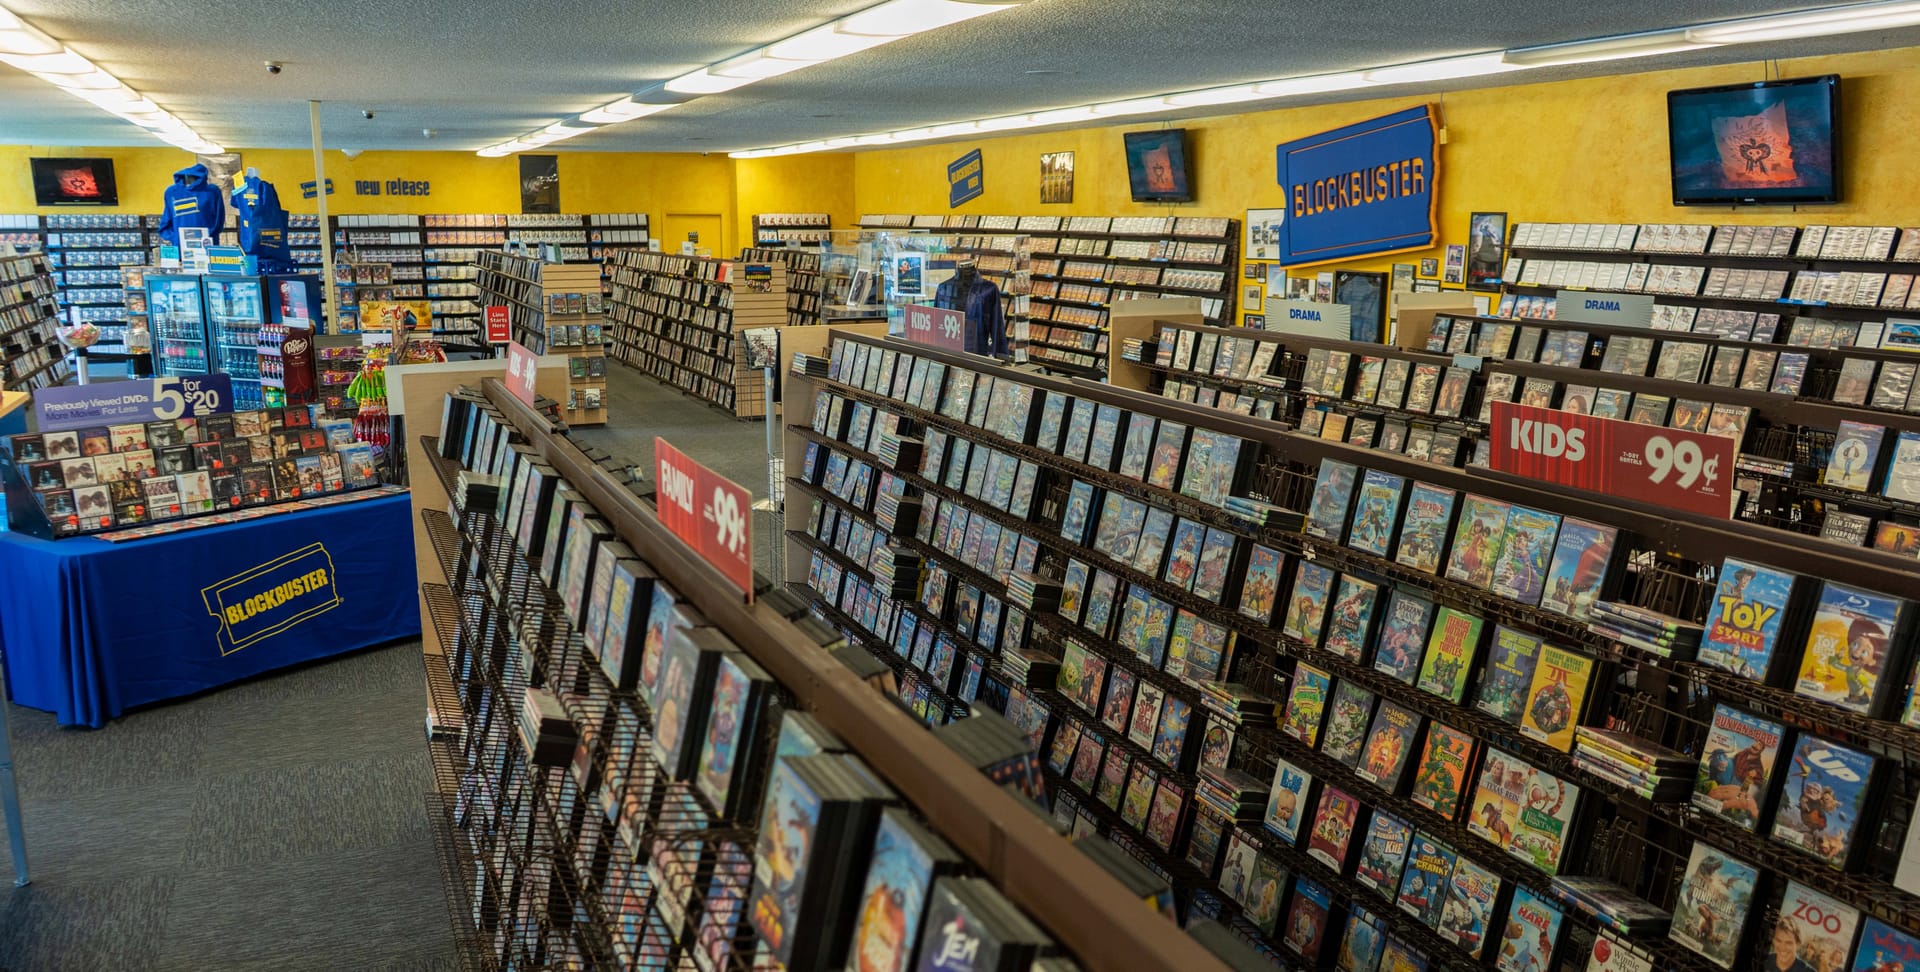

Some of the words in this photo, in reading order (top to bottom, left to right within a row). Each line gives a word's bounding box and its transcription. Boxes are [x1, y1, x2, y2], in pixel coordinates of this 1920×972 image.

[355, 180, 381, 195] new
[386, 178, 430, 196] release
[1293, 156, 1425, 218] BLOCKBUSTER
[1289, 308, 1322, 322] DRAMA
[1584, 299, 1622, 313] DRAMA
[911, 312, 931, 331] KIDS
[181, 379, 201, 392] for
[44, 397, 90, 412] Previously
[90, 396, 121, 408] Viewed
[123, 394, 149, 404] DVDs
[152, 377, 186, 420] 5
[185, 389, 220, 411] $20
[46, 411, 69, 421] More
[70, 409, 101, 419] Movies
[102, 406, 117, 416] For
[118, 405, 139, 414] Less
[1510, 417, 1586, 462] KIDS
[660, 458, 694, 516] FAMILY
[226, 567, 329, 626] BLOCKBUSTER
[1718, 594, 1777, 633] TOY
[1715, 624, 1762, 646] STORY
[1816, 634, 1838, 648] TOY
[1807, 749, 1861, 783] UP
[1415, 859, 1449, 877] CRANKY
[1517, 906, 1551, 930] HARE
[1792, 898, 1841, 934] ZOO
[935, 921, 980, 965] JEM
[1614, 949, 1640, 969] Winnie
